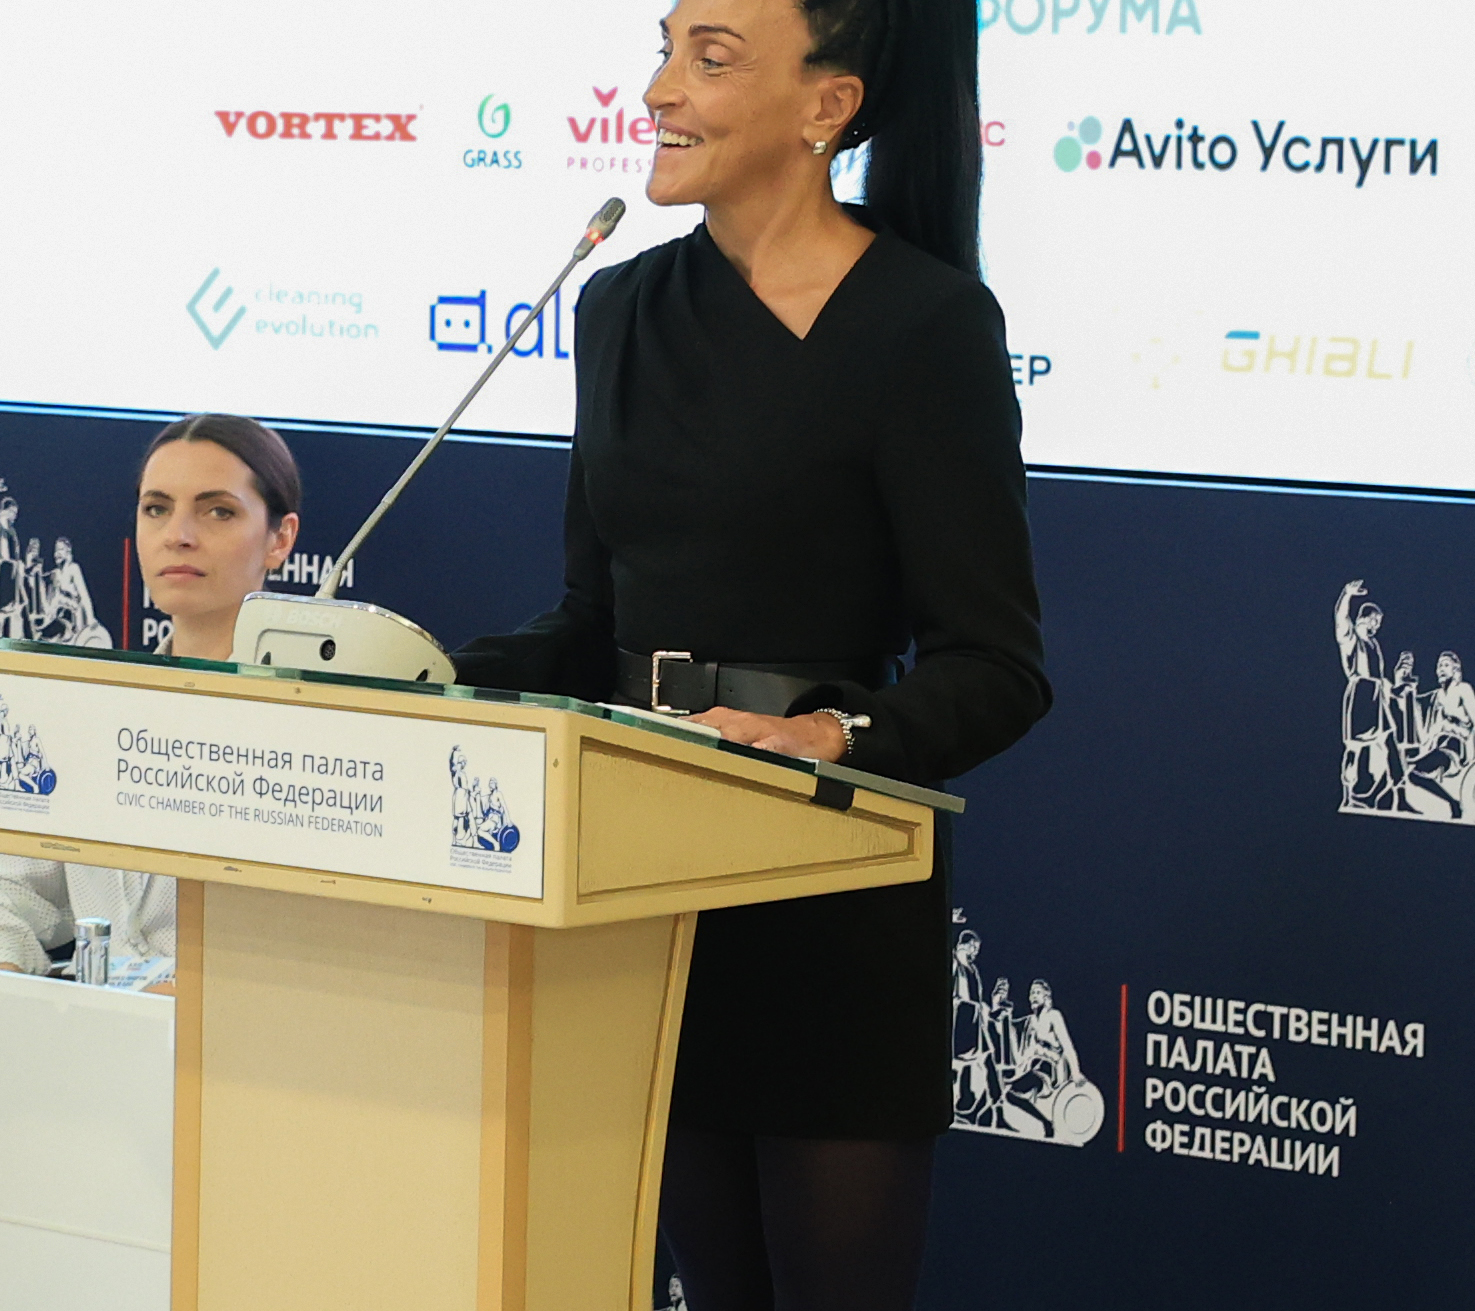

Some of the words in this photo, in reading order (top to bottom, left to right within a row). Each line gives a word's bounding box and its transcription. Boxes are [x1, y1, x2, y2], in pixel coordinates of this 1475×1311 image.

[214, 109, 418, 143] VORTEX
[566, 107, 656, 145] vile
[463, 149, 523, 169] GRASS
[1108, 118, 1238, 173] Avito
[1251, 120, 1439, 188] Услуги
[255, 315, 379, 339] evolution
[1221, 330, 1414, 380] GHIBLI
[116, 726, 292, 772] Общественная
[302, 752, 385, 782] палата
[116, 759, 246, 799] Российской
[252, 775, 384, 816] Федерации
[116, 793, 147, 809] CIVIC
[148, 796, 203, 816] CHAMBER
[206, 801, 224, 817] OF
[227, 803, 251, 820] THE
[253, 806, 304, 827] RUSSIAN
[307, 812, 384, 837] FEDERATION
[1145, 988, 1426, 1059] ОБЩЕСТВЕННАЯ
[1144, 1034, 1276, 1084] ПАЛАТА
[1144, 1076, 1358, 1139] РОССИЙСКОЙ
[1144, 1119, 1339, 1178] ФЕДЕРАЦИИ
